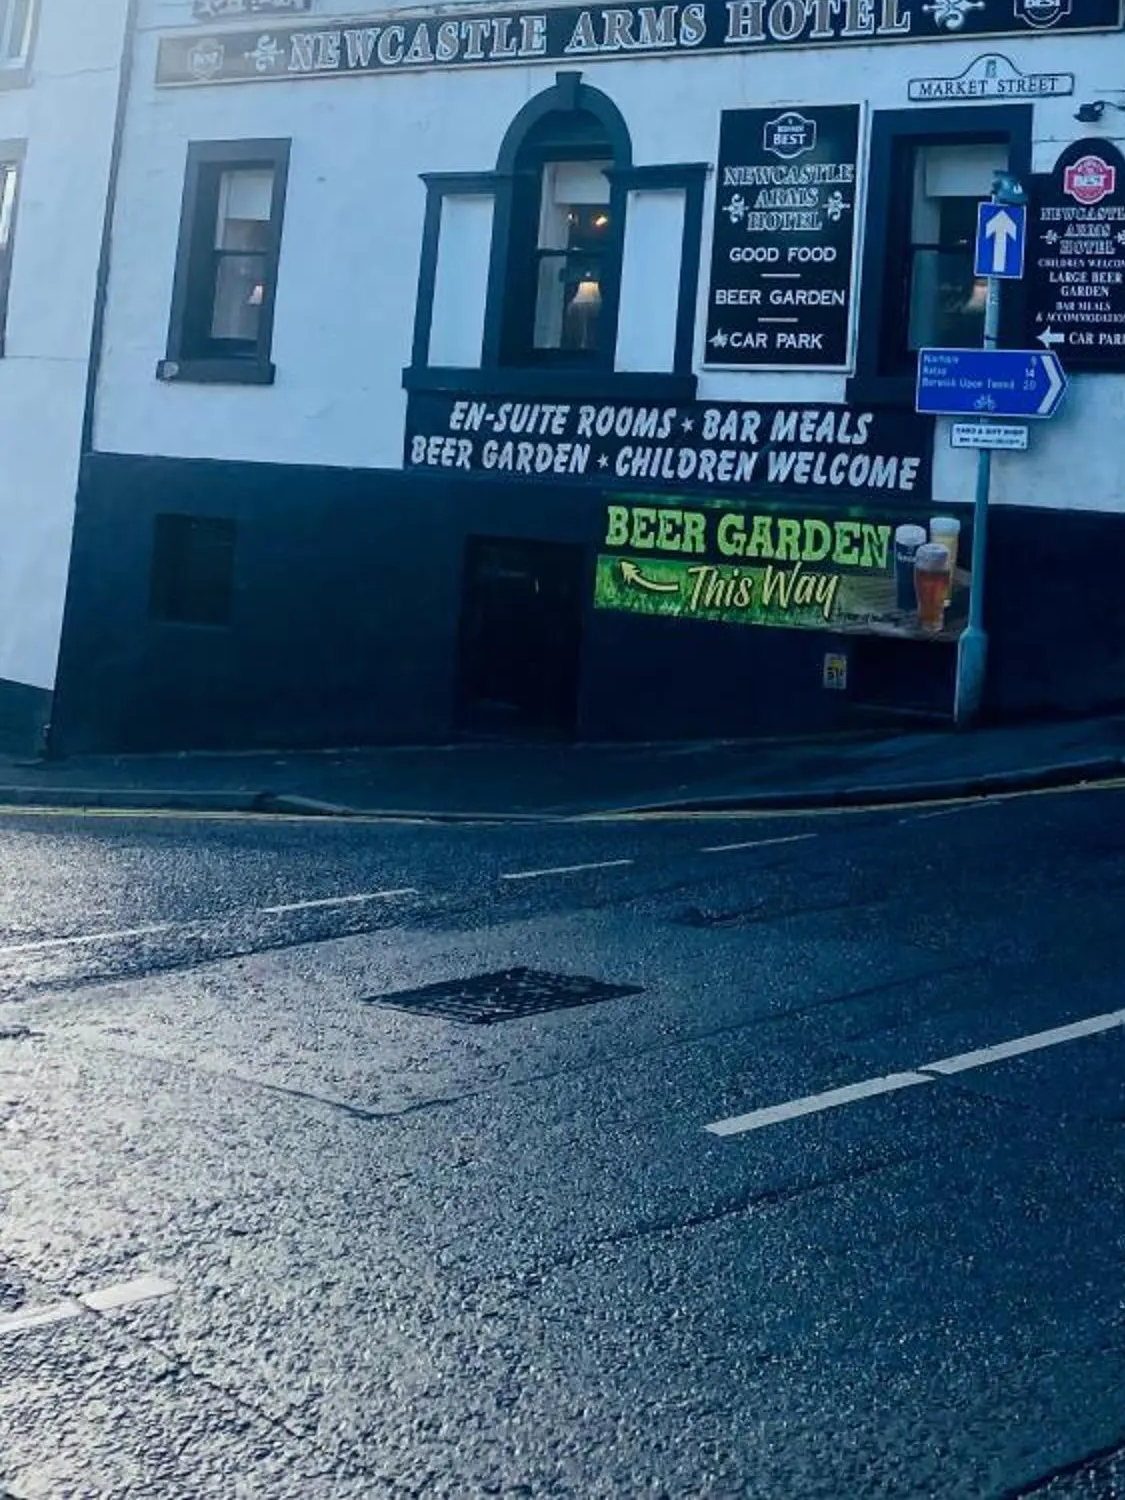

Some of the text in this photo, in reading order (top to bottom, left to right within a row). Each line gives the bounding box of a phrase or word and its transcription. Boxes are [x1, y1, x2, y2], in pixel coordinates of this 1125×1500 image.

[287, 14, 548, 71] NEWCASTLE
[564, 3, 708, 55] ARMS
[919, 77, 1058, 96] MARKET STREET
[773, 133, 808, 145] BEST
[723, 162, 855, 186] NEWCASTLE
[752, 187, 820, 210] ARMS
[746, 210, 823, 232] HOTEL
[1063, 222, 1112, 238] ARMS
[729, 246, 838, 263] GOOD FOOD
[1059, 239, 1116, 255] HOTEL
[1037, 258, 1085, 269] CHILDREN
[1049, 270, 1123, 284] LARGE BEER
[715, 288, 846, 307] BEER GARDEN
[1060, 284, 1110, 297] GARDEN
[1055, 301, 1112, 311] BAR MEALS
[729, 332, 825, 349] CAR PARK
[1068, 331, 1094, 345] CAR
[449, 400, 873, 446] EN-SUITE ROOMS BAR MEALS
[411, 434, 921, 491] BEER GARDEN CHILDREN WELCOME
[605, 504, 892, 569] BEER GARDEN
[687, 561, 840, 619] This Way
